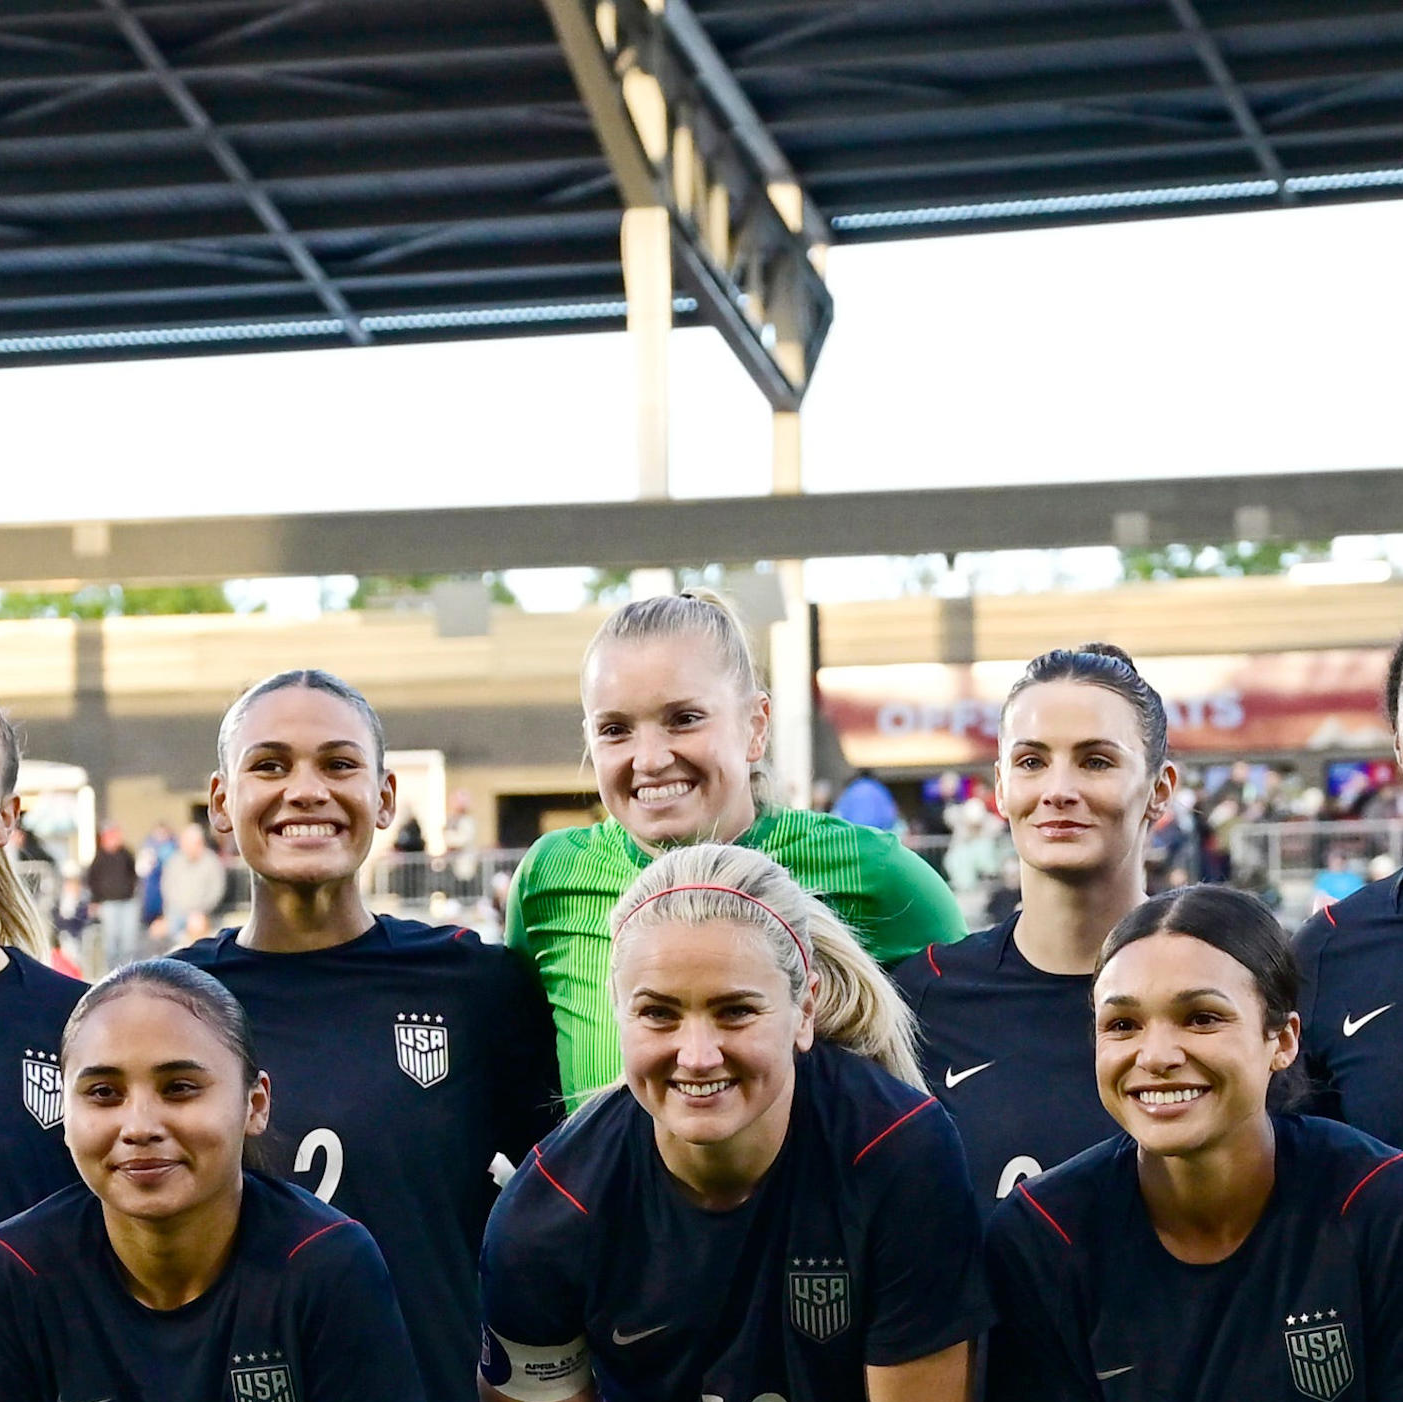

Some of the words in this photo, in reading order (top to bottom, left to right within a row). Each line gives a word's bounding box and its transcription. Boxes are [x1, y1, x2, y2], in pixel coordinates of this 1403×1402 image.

[399, 1027, 444, 1052] USA
[294, 1128, 344, 1205] 2
[795, 1278, 844, 1305] USA
[1291, 1329, 1342, 1361] USA
[237, 1370, 286, 1400] USA
